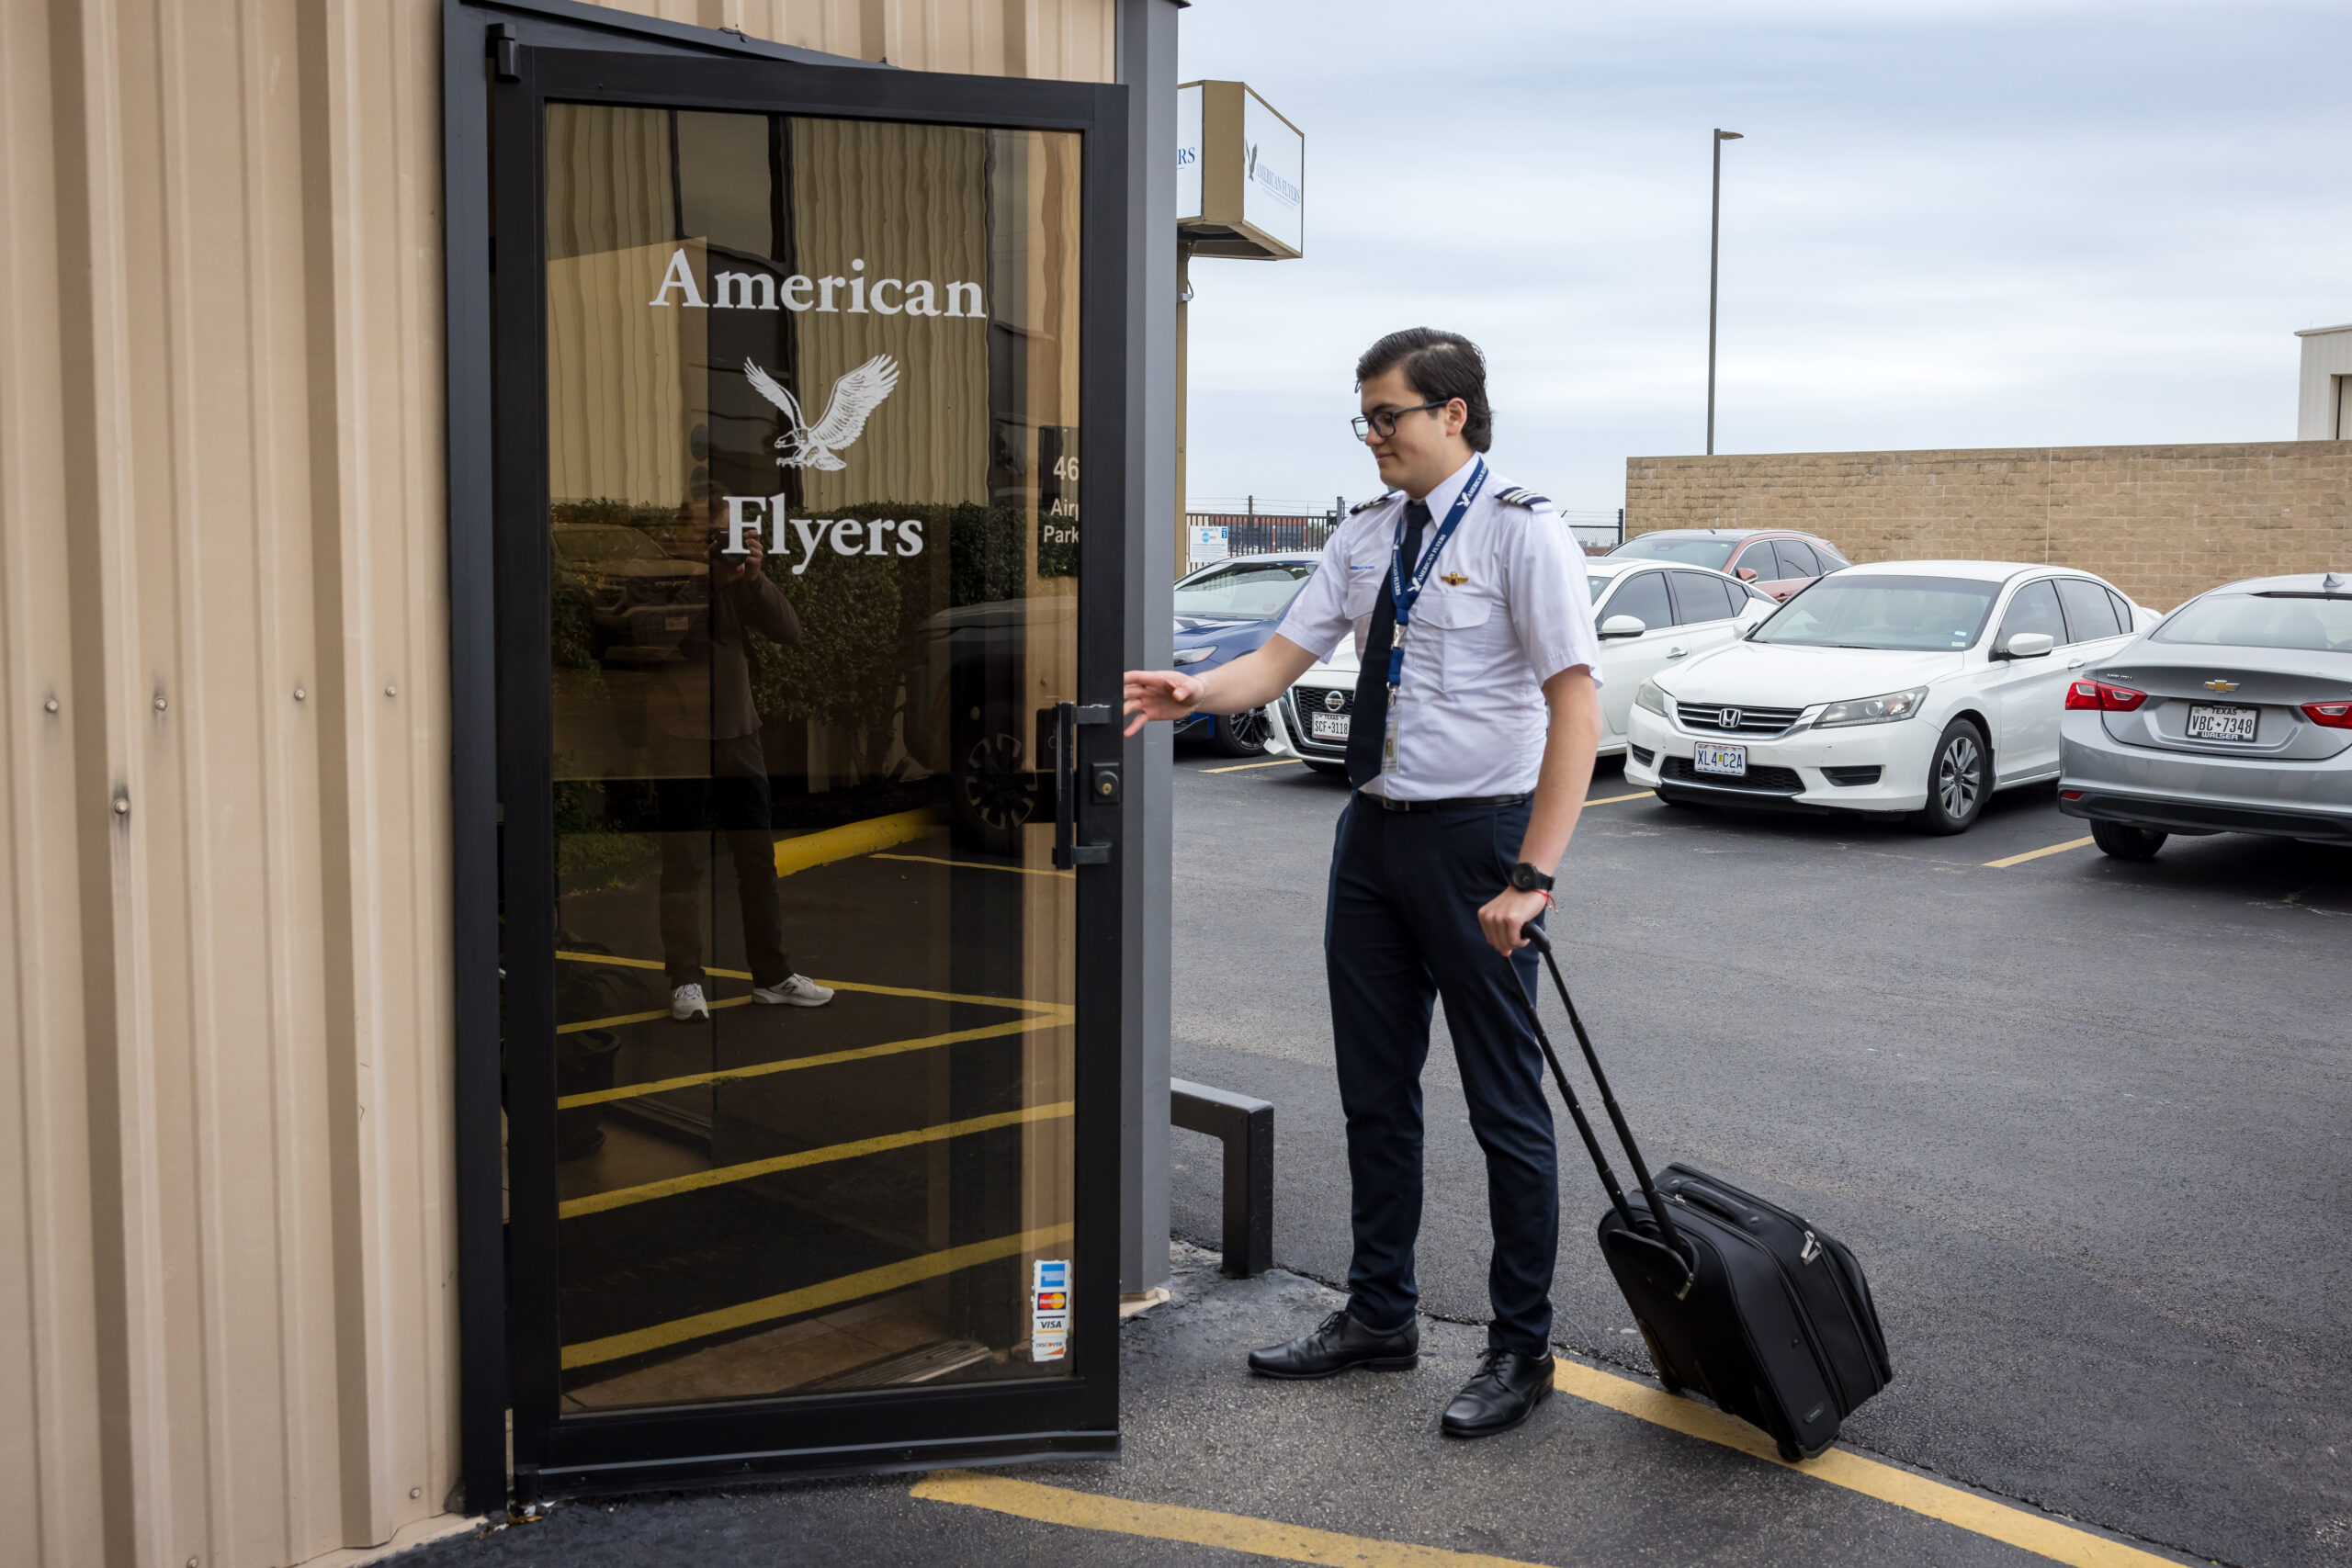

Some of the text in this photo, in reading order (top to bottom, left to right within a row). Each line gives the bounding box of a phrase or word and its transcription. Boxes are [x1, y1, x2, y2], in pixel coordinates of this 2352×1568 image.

[1178, 147, 1195, 164] RS
[1256, 162, 1282, 193] AMERICAN
[1283, 179, 1300, 204] FLYERS
[649, 248, 987, 318] American
[1053, 456, 1079, 481] 46
[721, 493, 923, 575] Flyers
[1418, 534, 1446, 582] AMERICAN FLYERS
[2201, 731, 2238, 740] WALSER
[1041, 1320, 1062, 1329] VISA
